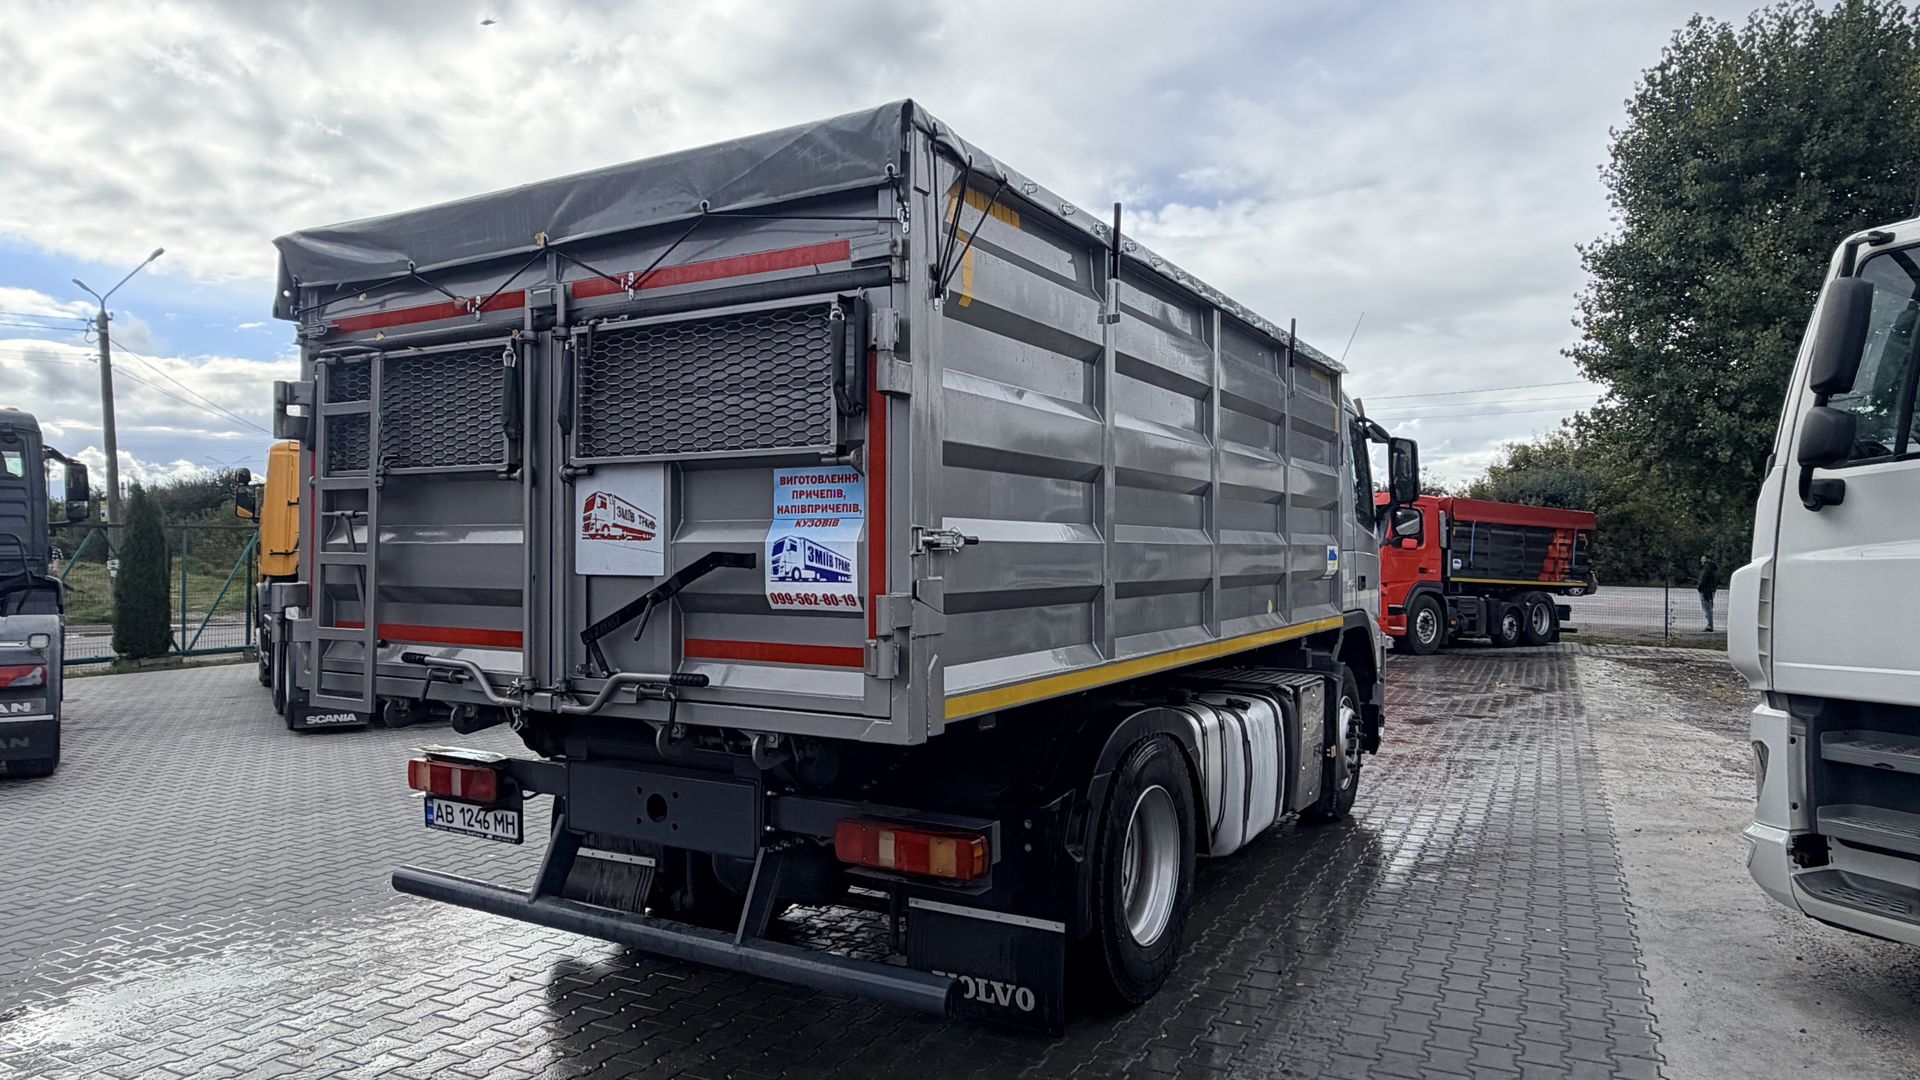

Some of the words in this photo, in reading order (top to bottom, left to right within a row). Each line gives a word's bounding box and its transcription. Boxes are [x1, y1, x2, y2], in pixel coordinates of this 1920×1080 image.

[780, 474, 859, 485] ВИГОТОВЛЕННЯ
[792, 489, 846, 499] ПРИЧЕПІВ,
[777, 503, 862, 515] НАПІВПРИЧЕПІВ,
[795, 519, 840, 528] КУЗОВІВ
[770, 593, 857, 607] 099-562-80-19
[306, 713, 357, 724] SCANIA
[459, 807, 490, 830] 1246
[932, 970, 1035, 1011] OLVO
